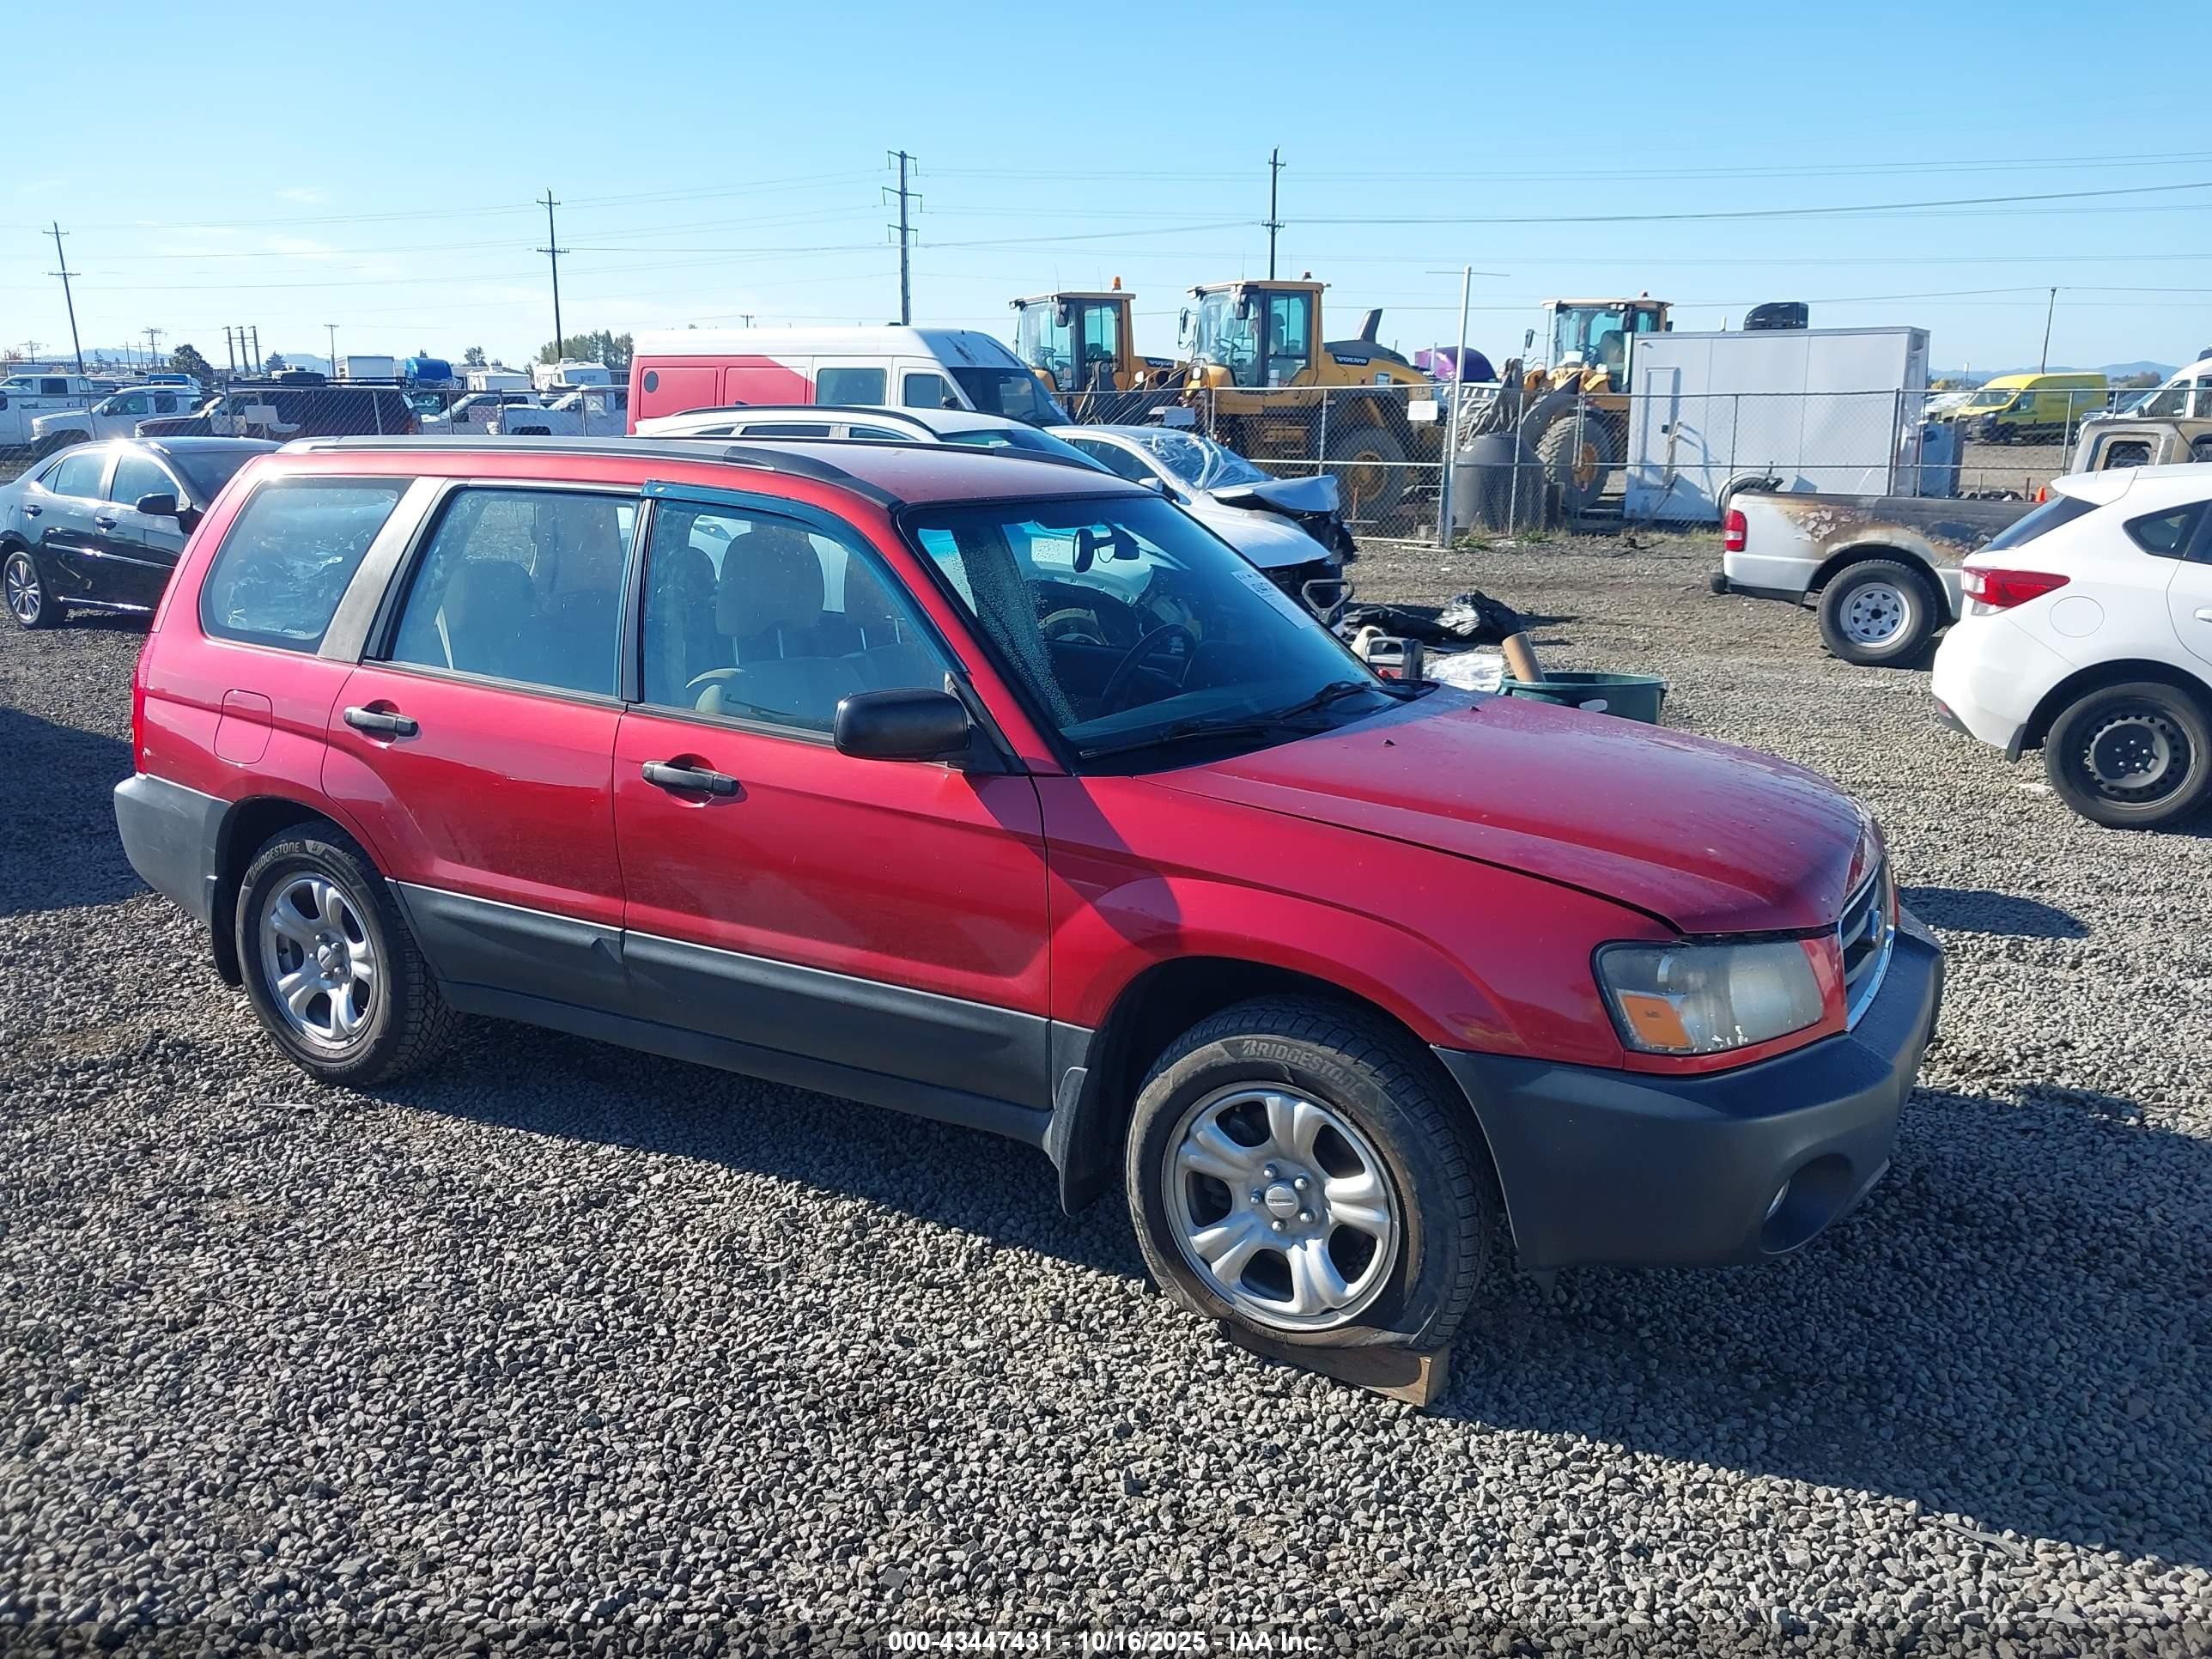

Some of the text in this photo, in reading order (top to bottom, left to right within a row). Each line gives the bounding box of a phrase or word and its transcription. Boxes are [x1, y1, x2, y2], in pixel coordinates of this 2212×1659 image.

[1335, 356, 1368, 364] VOLVO
[249, 842, 301, 881] BRIDGESTONE
[1243, 1040, 1367, 1095] BRIDGESTONE
